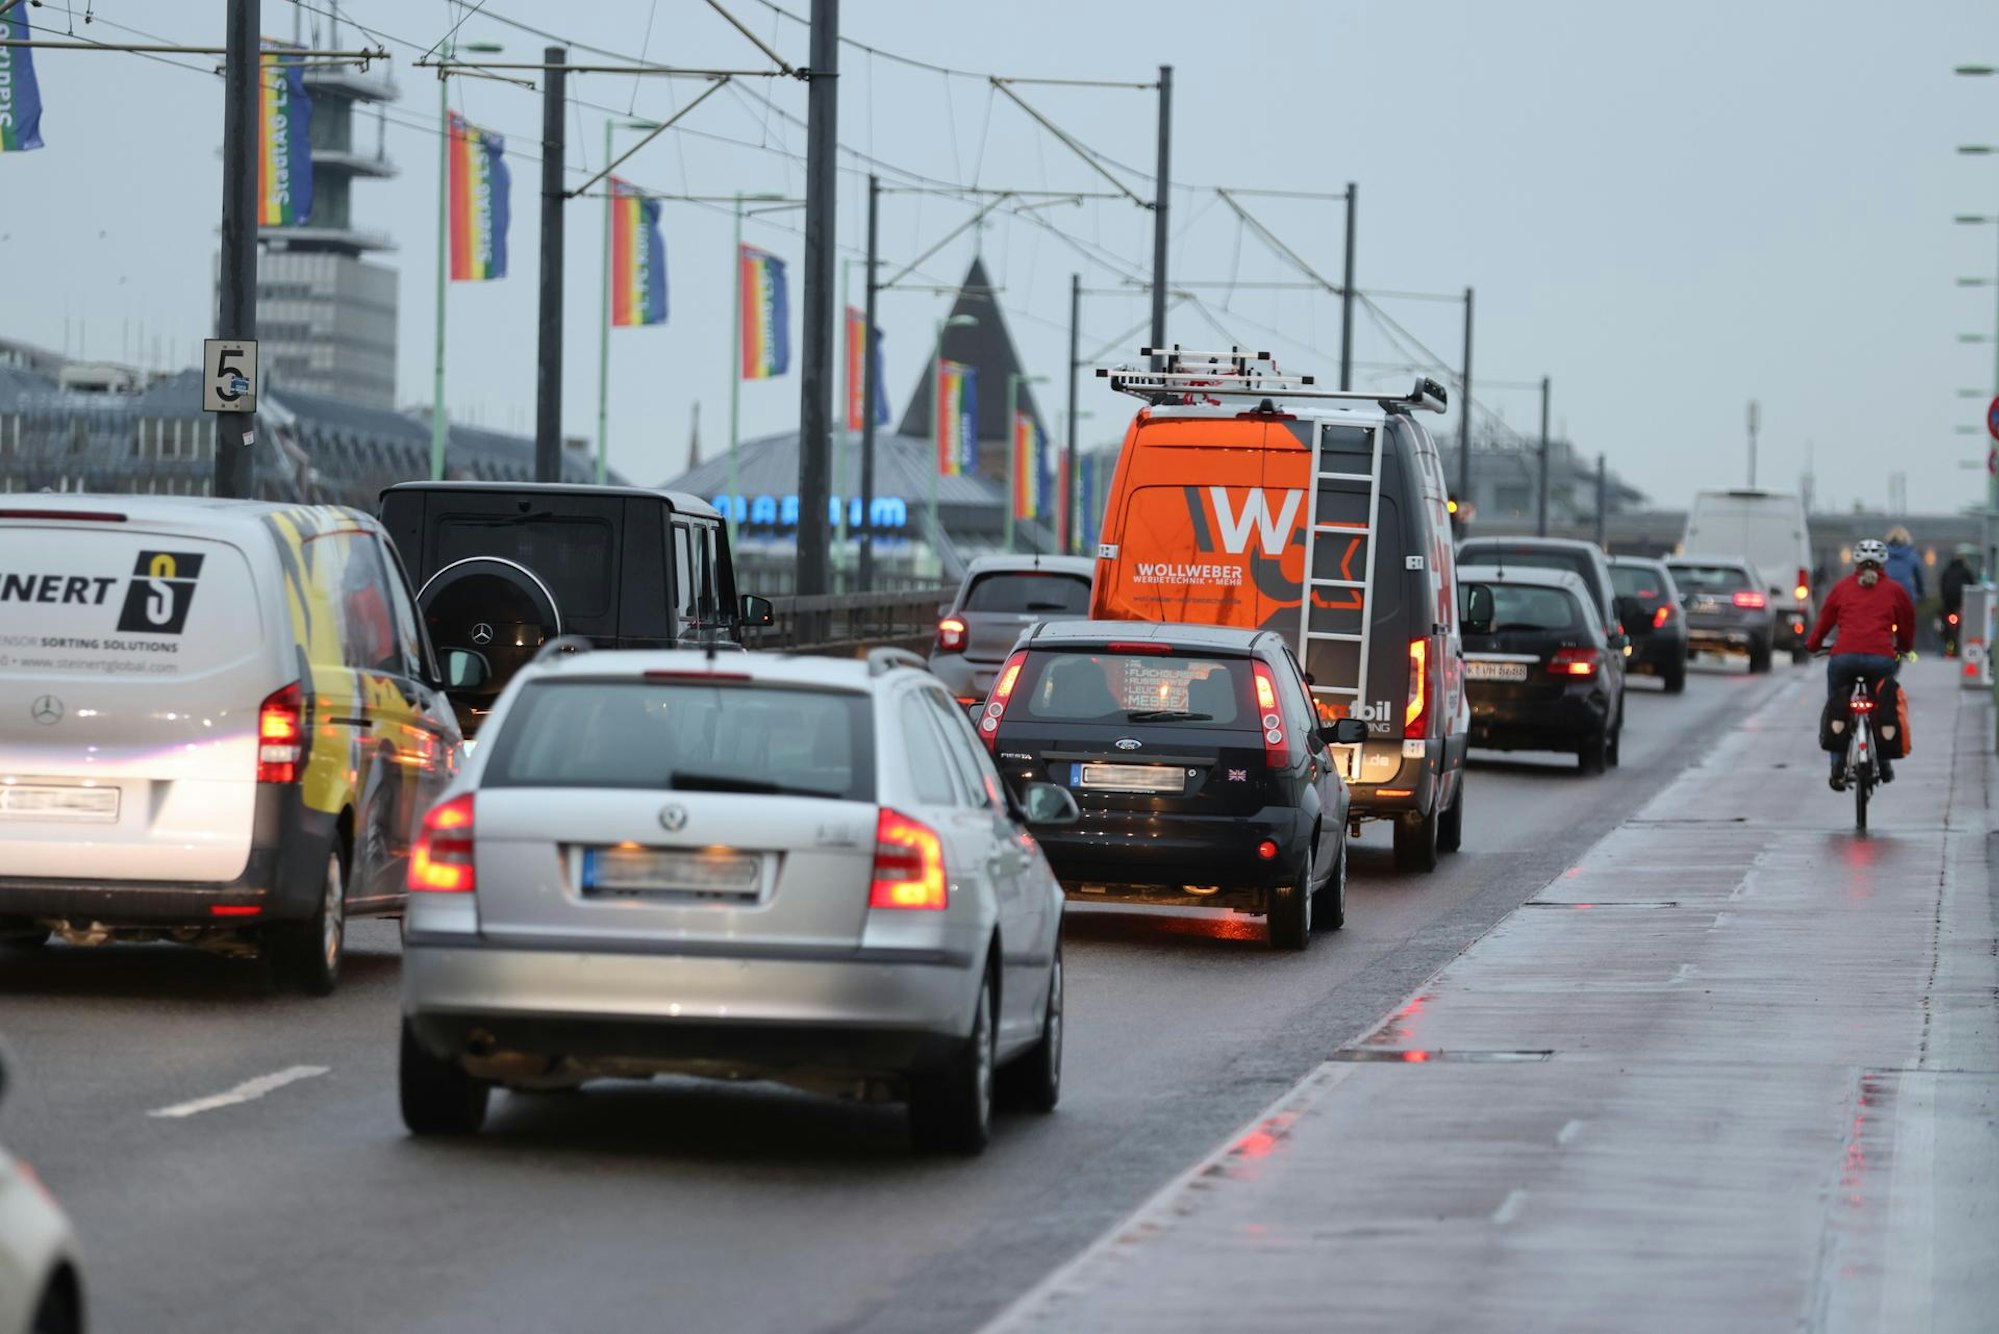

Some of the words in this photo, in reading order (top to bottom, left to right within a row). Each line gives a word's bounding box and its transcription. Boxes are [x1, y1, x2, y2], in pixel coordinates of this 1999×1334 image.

[216, 350, 244, 401] 5
[1138, 563, 1242, 579] WOLLWEBER
[0, 572, 117, 605] NERT
[41, 636, 99, 650] SORTING
[103, 639, 178, 653] SOLUTIONS
